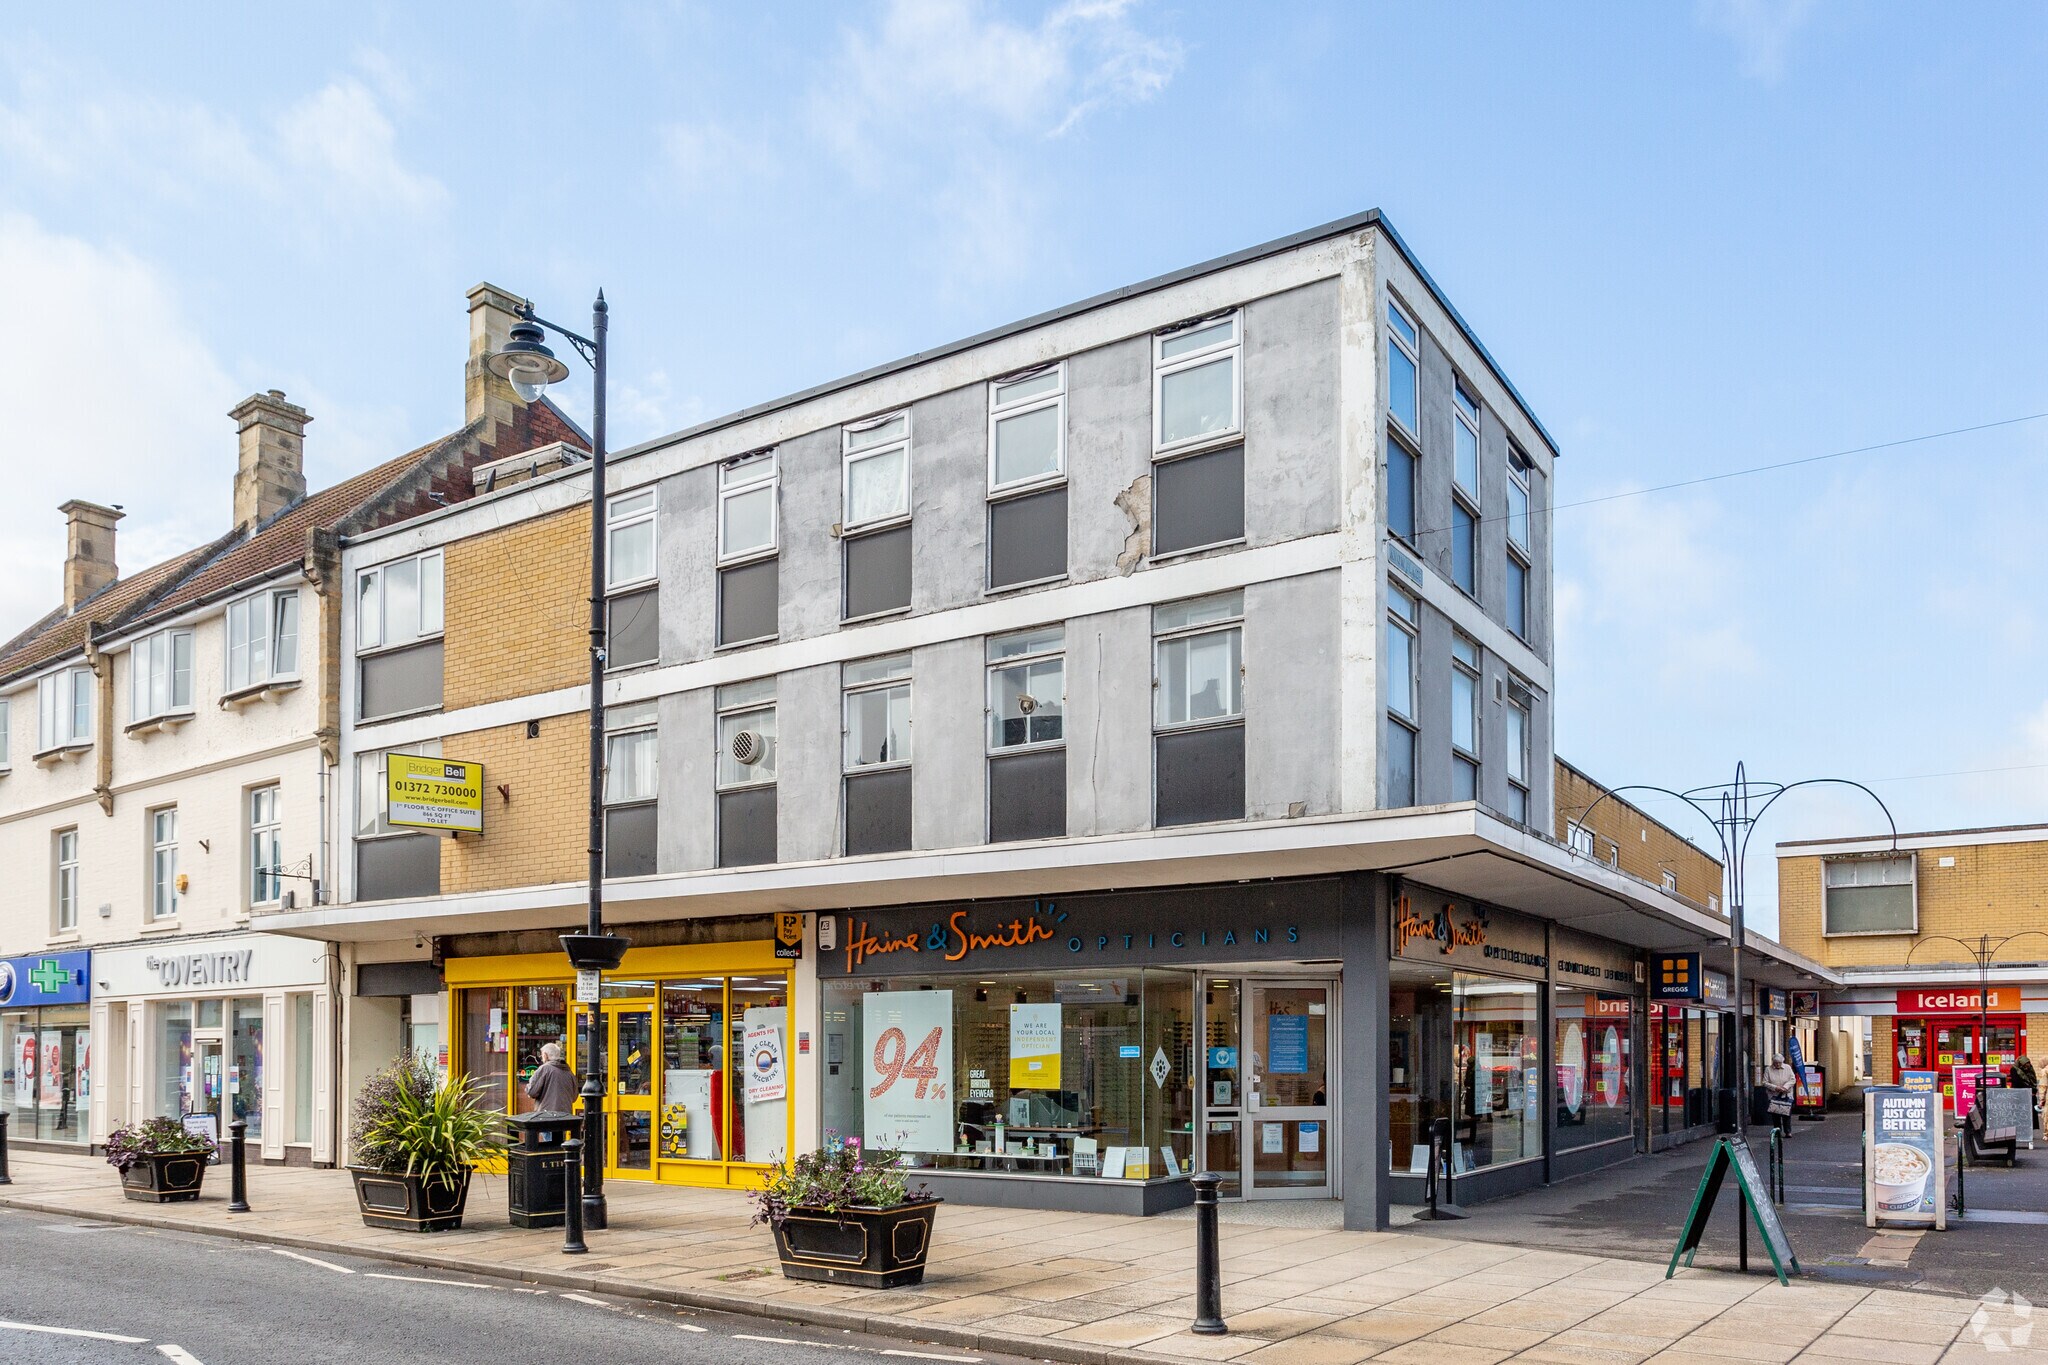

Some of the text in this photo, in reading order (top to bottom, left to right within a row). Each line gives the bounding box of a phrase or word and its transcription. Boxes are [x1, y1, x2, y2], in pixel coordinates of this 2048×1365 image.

[408, 763, 465, 777] Bridger Bell
[395, 781, 476, 798] 01372 730000
[405, 795, 468, 806] www.bridgerbell.com
[1398, 894, 1435, 956] Haine
[1446, 904, 1488, 954] Smith
[846, 911, 1054, 973] Haine & Smith
[1068, 927, 1298, 952] OPTICIANS
[160, 950, 252, 986] COVENTRY
[1918, 992, 1998, 1008] Iceland
[750, 1040, 778, 1058] THE CLEAN
[970, 1070, 985, 1078] GREAT
[760, 1084, 784, 1092] CLEANING
[970, 1089, 994, 1098] EYEWEAR
[1882, 1098, 1926, 1108] AUTUMN
[1882, 1109, 1926, 1118] JUST GOT
[1882, 1119, 1926, 1130] BETTER
